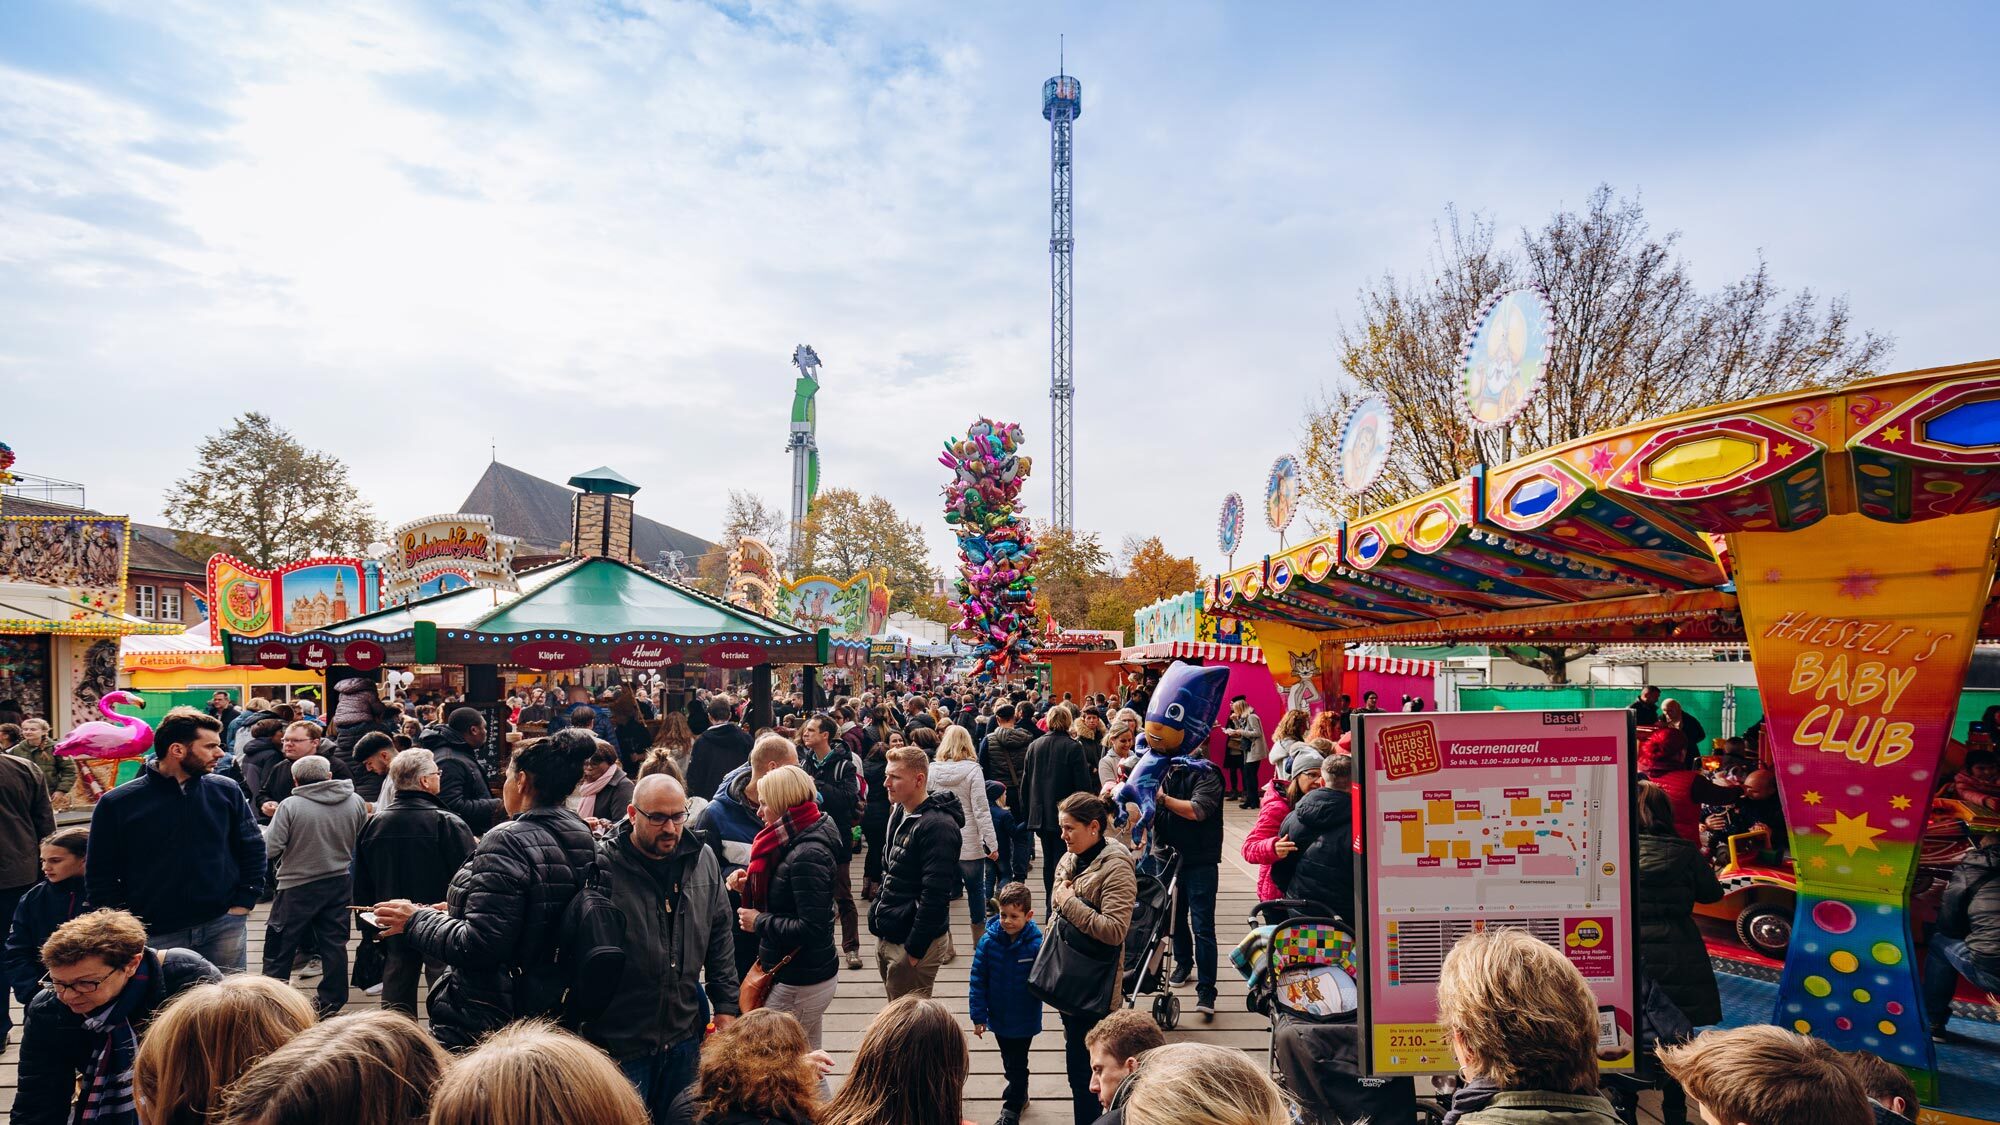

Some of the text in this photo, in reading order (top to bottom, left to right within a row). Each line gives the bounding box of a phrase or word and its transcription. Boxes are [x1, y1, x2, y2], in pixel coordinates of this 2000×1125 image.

[538, 651, 566, 661] Klöpfer
[632, 644, 662, 658] Howald
[721, 651, 750, 660] Getränke
[621, 657, 672, 668] Holzkohlengrill
[1788, 651, 1917, 714] BABY
[1544, 712, 1578, 724] Basel
[1393, 730, 1421, 741] BASLER
[1793, 704, 1915, 767] CLUB
[1388, 735, 1430, 754] HERBST
[1450, 741, 1539, 755] Kasernenareal
[1390, 746, 1433, 767] MESSE
